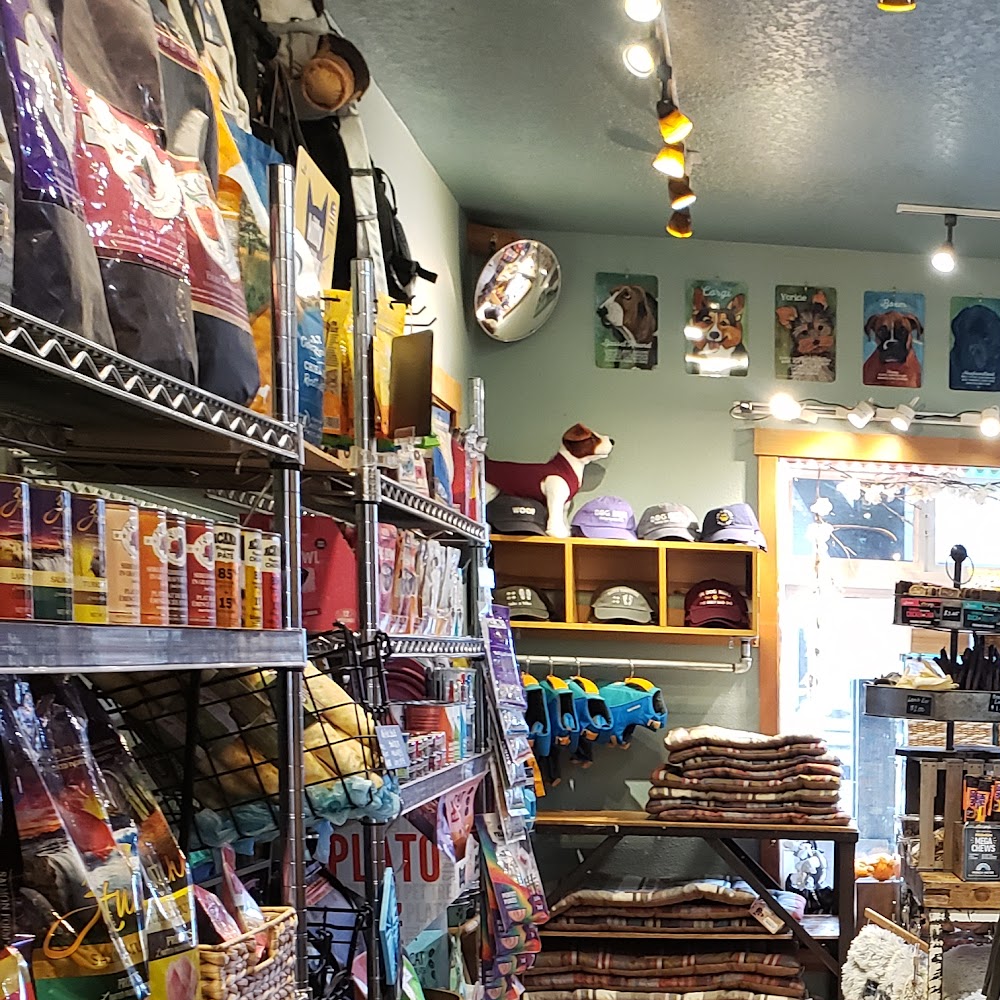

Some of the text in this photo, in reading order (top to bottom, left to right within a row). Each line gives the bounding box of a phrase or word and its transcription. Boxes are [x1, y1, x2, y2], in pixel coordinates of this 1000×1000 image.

[703, 285, 732, 299] Corgi
[780, 292, 807, 302] Yorkie
[218, 567, 233, 580] 85
[219, 597, 233, 609] 15
[974, 837, 993, 846] MEGA
[970, 844, 996, 853] CHEWS
[329, 833, 440, 883] PLTO
